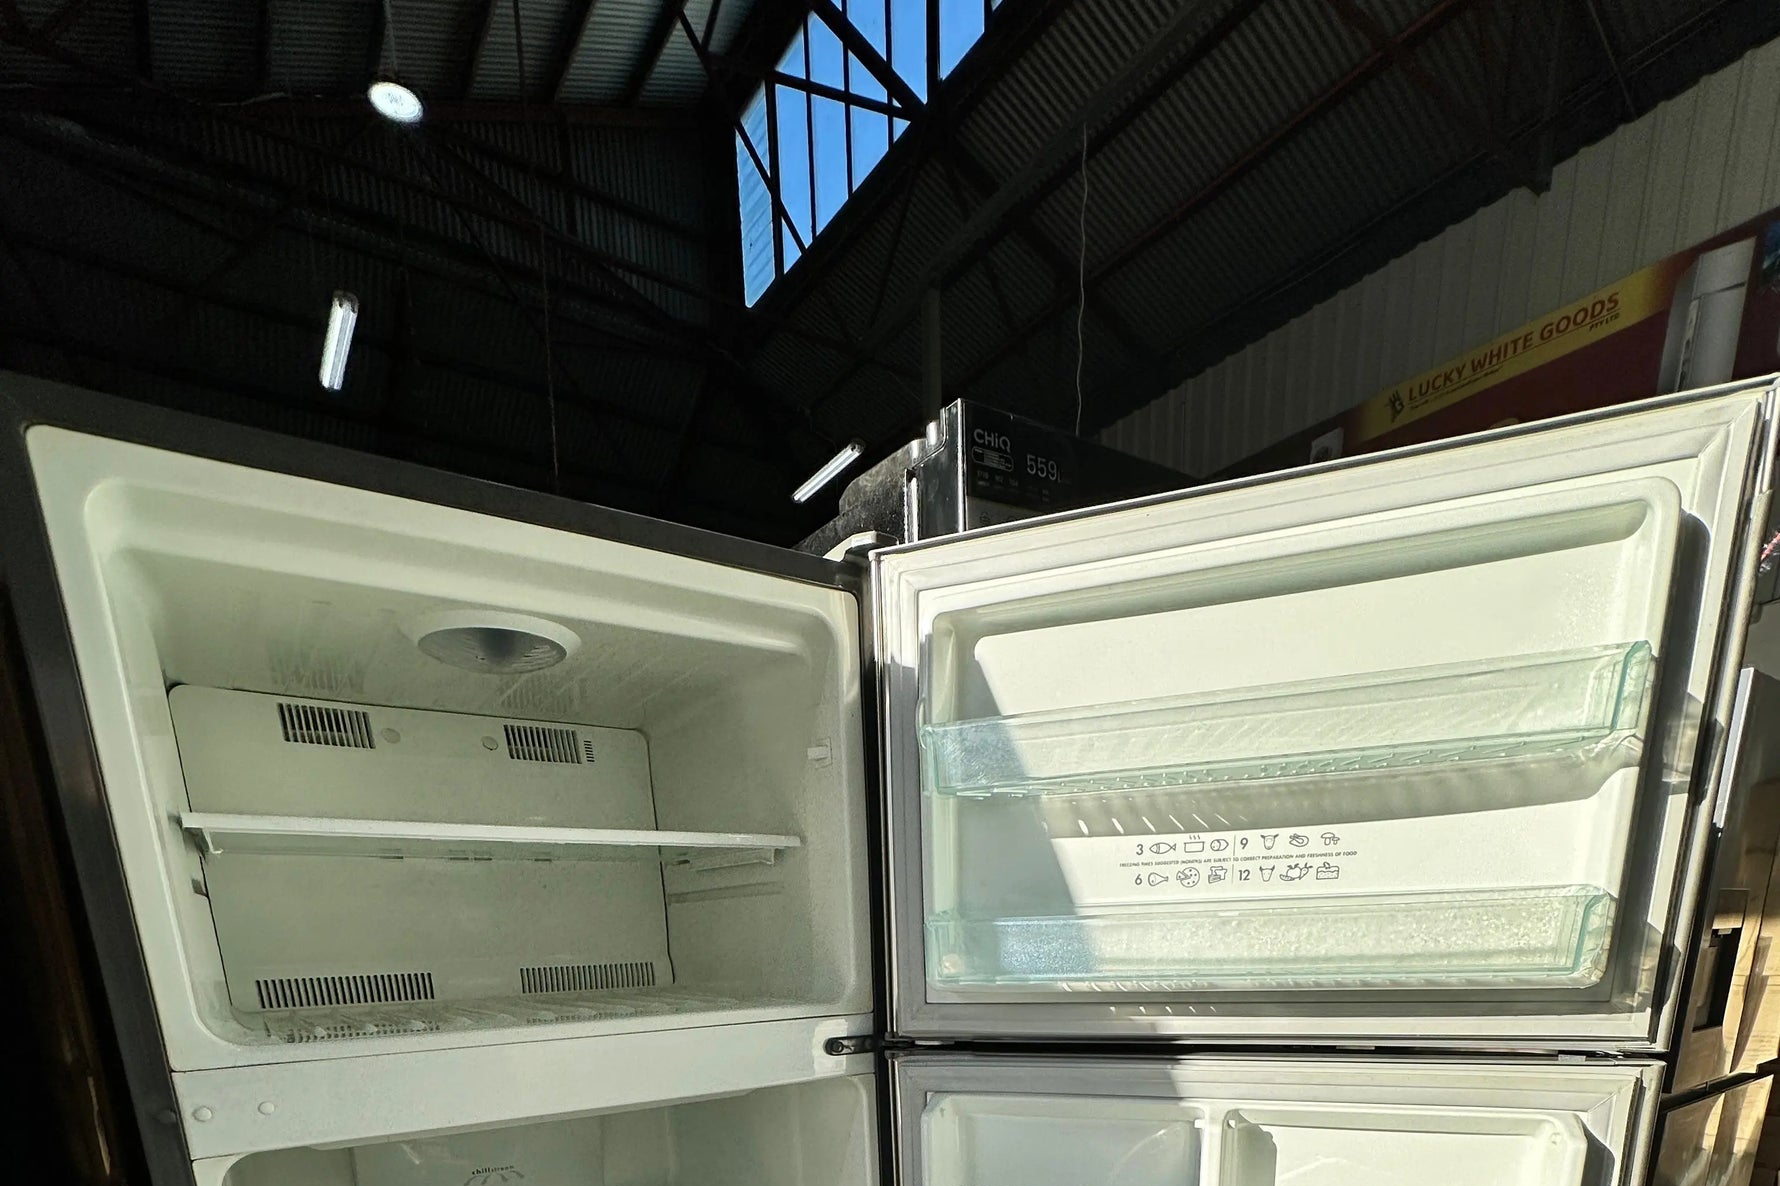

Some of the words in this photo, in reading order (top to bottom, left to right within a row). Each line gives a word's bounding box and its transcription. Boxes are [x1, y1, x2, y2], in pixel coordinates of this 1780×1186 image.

[1408, 363, 1466, 402] LUCKY
[1471, 332, 1534, 373] WHITE
[1540, 292, 1621, 342] GOODS
[1136, 843, 1144, 856] 3
[1240, 837, 1249, 850] 9
[1135, 873, 1142, 885] 6
[1238, 869, 1251, 881] 12
